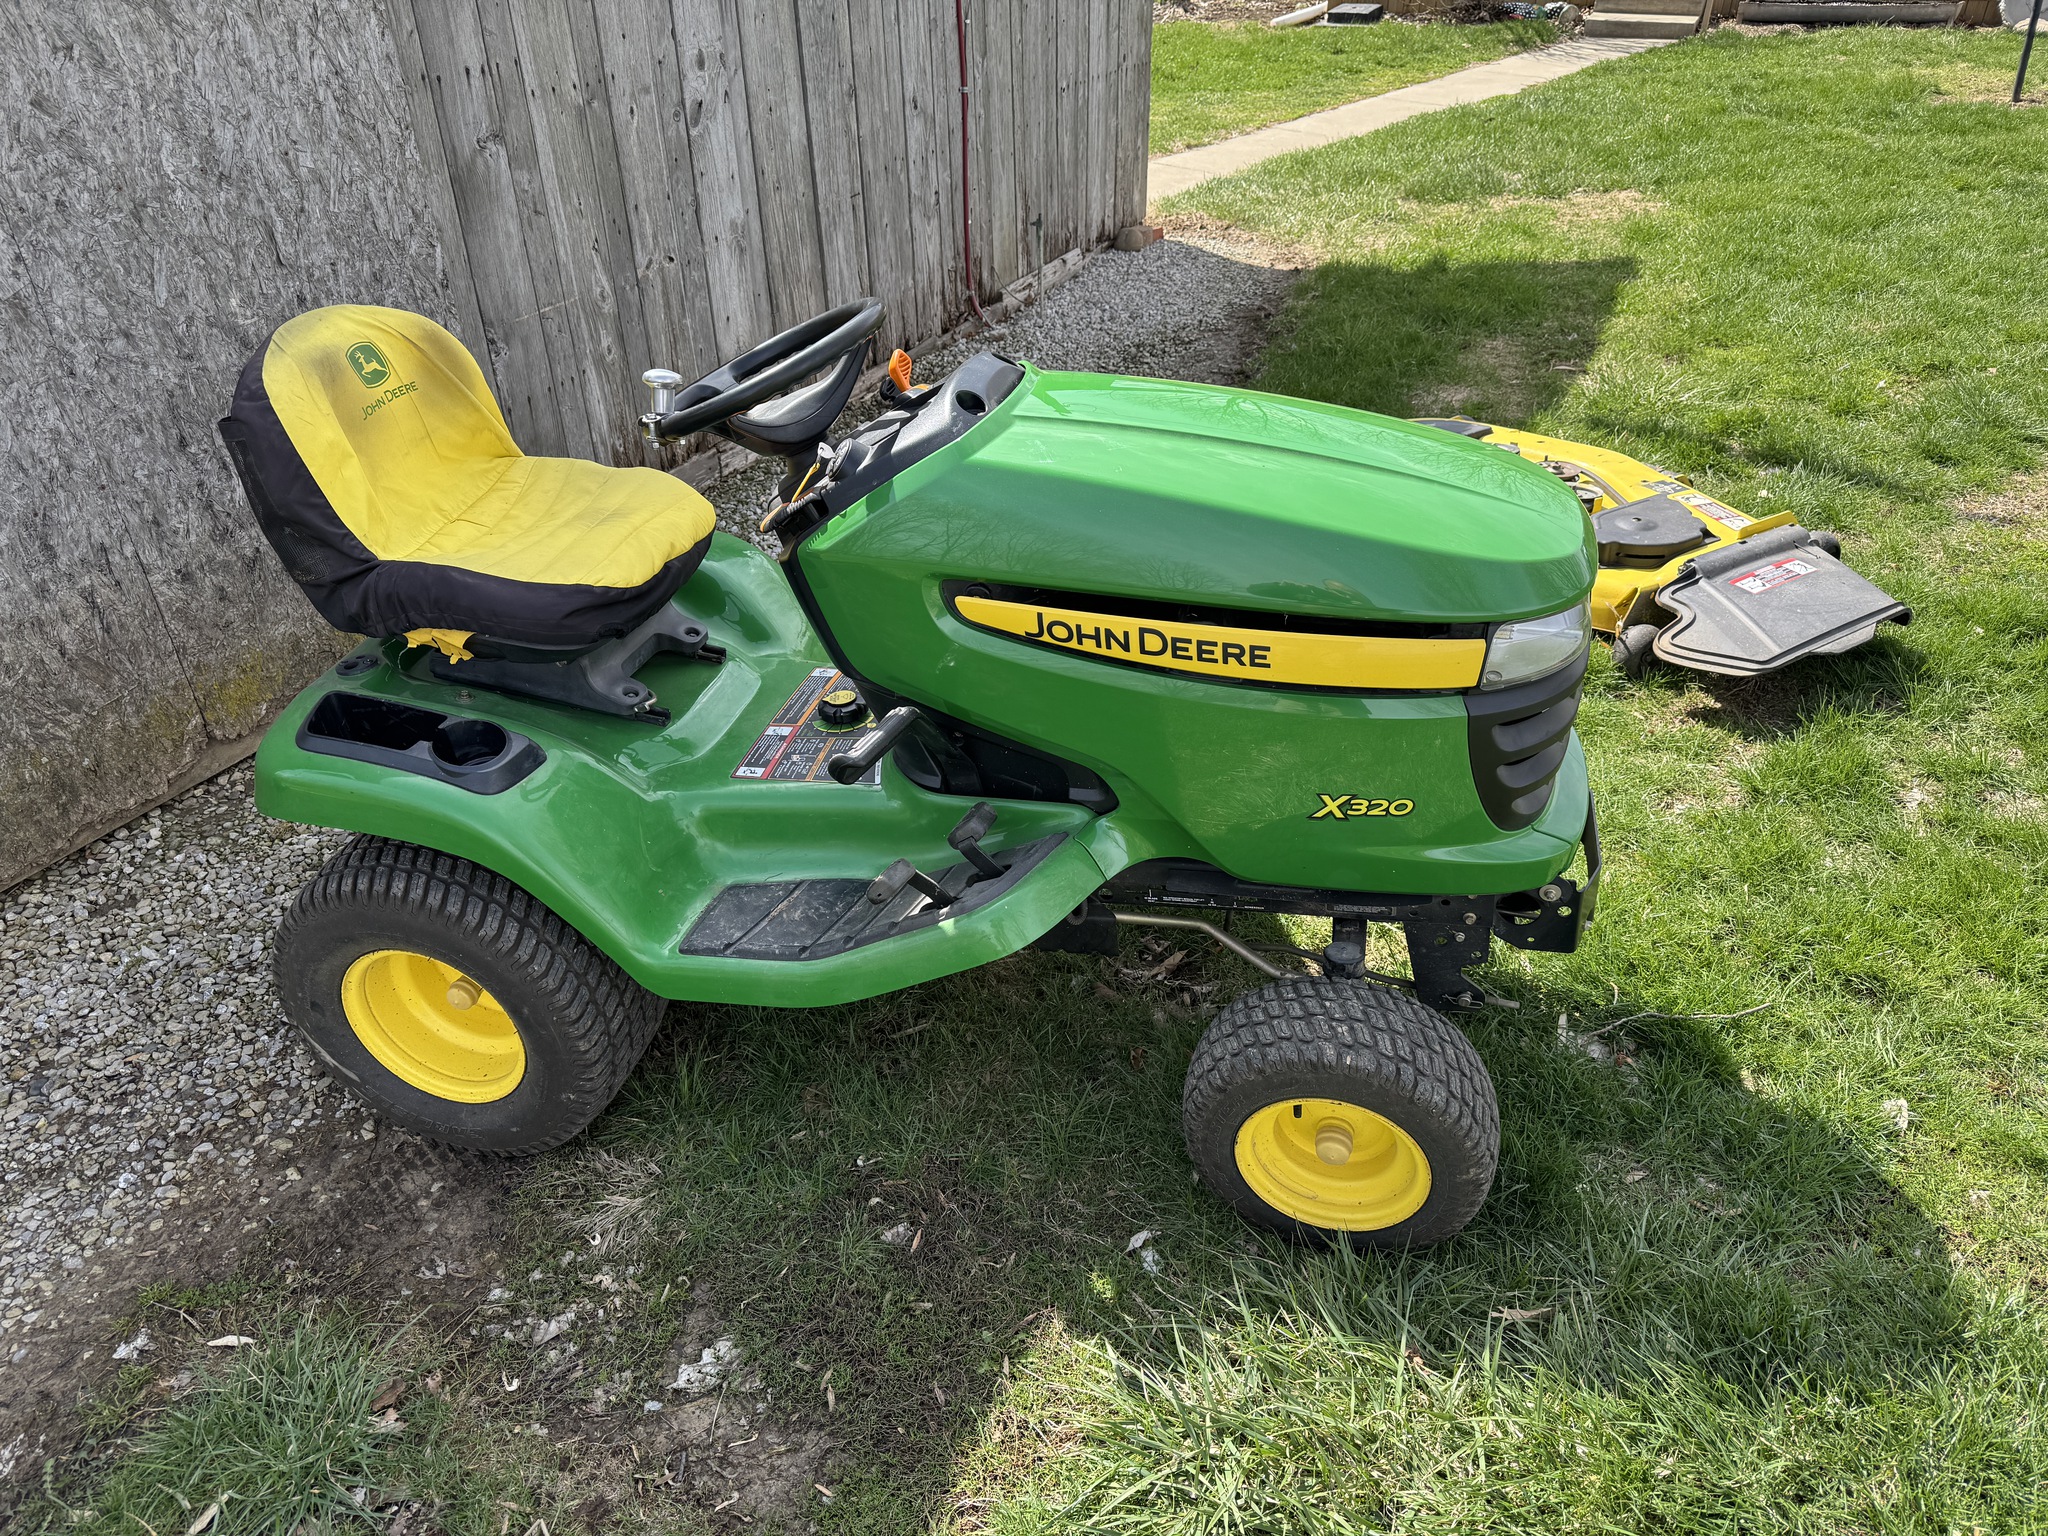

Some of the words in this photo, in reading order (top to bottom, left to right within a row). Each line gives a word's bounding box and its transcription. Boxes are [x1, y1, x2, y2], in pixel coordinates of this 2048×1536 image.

[361, 396, 386, 420] JOHN
[384, 381, 418, 402] DEERE
[1024, 612, 1132, 653] JOHN
[1138, 626, 1272, 669] DEERE
[1308, 794, 1415, 820] X320
